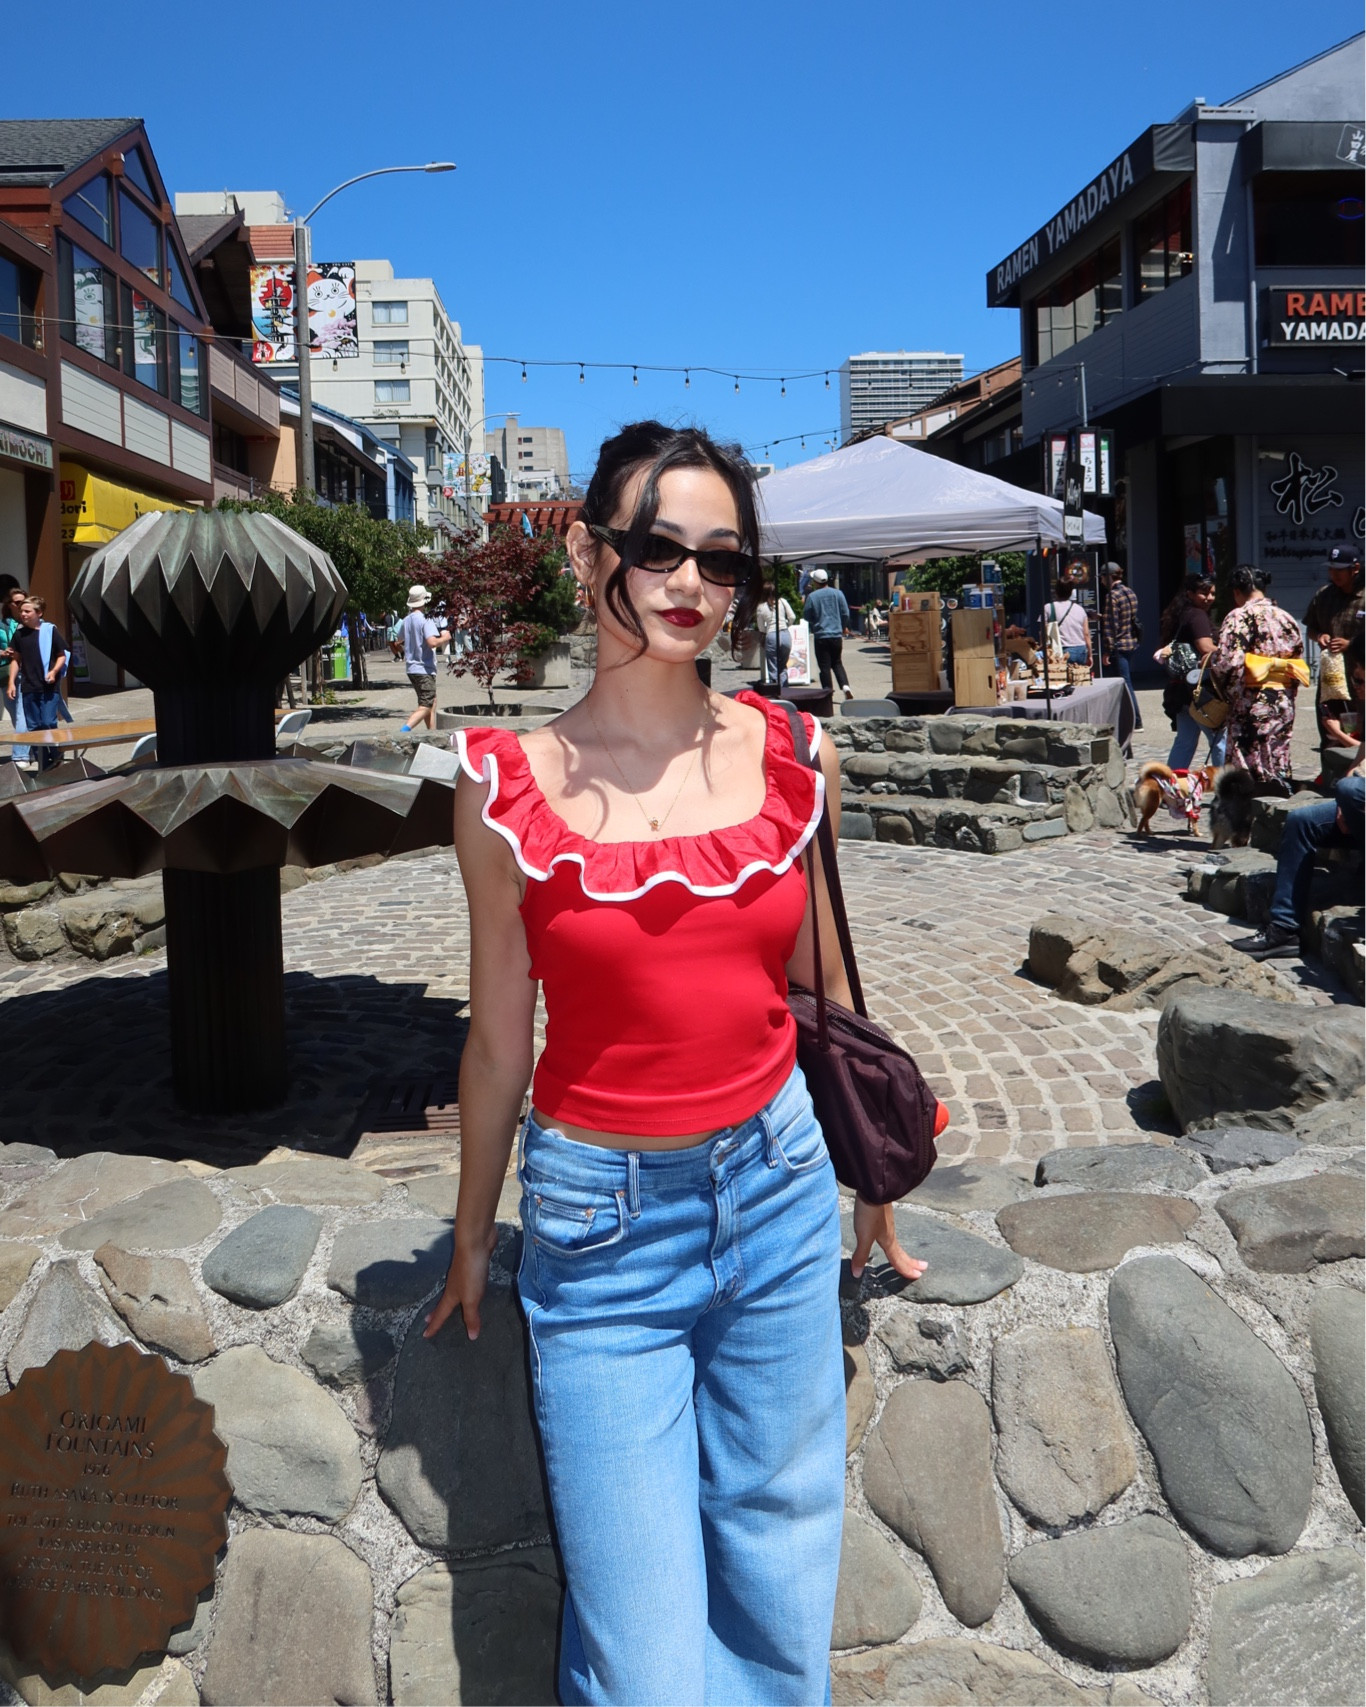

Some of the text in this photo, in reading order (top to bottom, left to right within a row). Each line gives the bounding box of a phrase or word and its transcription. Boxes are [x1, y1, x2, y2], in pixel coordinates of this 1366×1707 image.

[997, 153, 1134, 294] RAMEN YAMADAYA
[1270, 452, 1344, 525] 松
[60, 1410, 147, 1434] ORIGAMI
[46, 1433, 155, 1460] FOUNTAINS
[82, 1463, 111, 1478] 1976
[11, 1483, 48, 1499] RUTH
[102, 1488, 178, 1510] SCULPTOR
